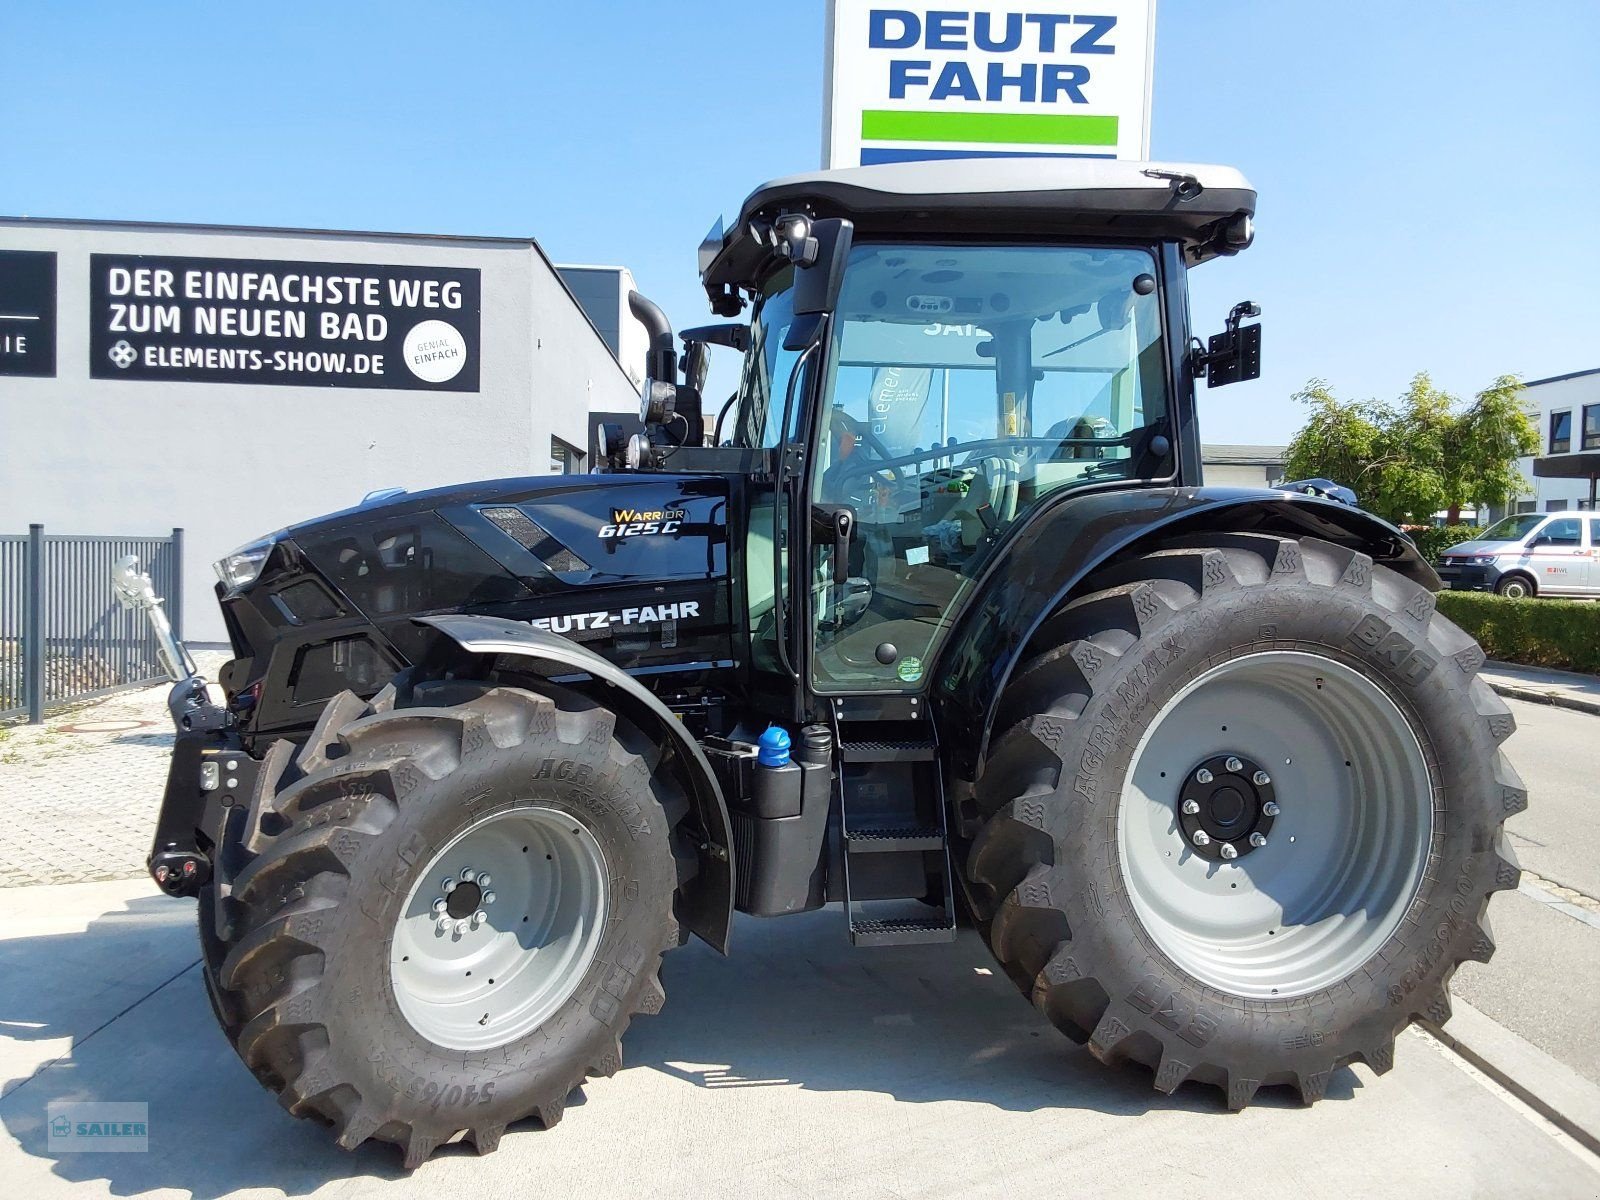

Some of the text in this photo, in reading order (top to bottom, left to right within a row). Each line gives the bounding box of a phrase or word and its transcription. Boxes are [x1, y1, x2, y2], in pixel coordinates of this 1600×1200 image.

[868, 9, 1118, 55] DEUTZ
[888, 60, 1091, 104] FAHR
[109, 267, 462, 309] DER EINFACHSTE WEG
[108, 304, 388, 341] ZUM NEUEN BAD
[144, 346, 385, 375] ELEMENTS-SHOW.DE
[414, 348, 458, 365] EINFACH
[417, 339, 450, 352] GENIAL
[597, 520, 681, 538] 6125 C
[522, 601, 700, 633] EUTZ-FAHR
[1346, 613, 1440, 688] BKT
